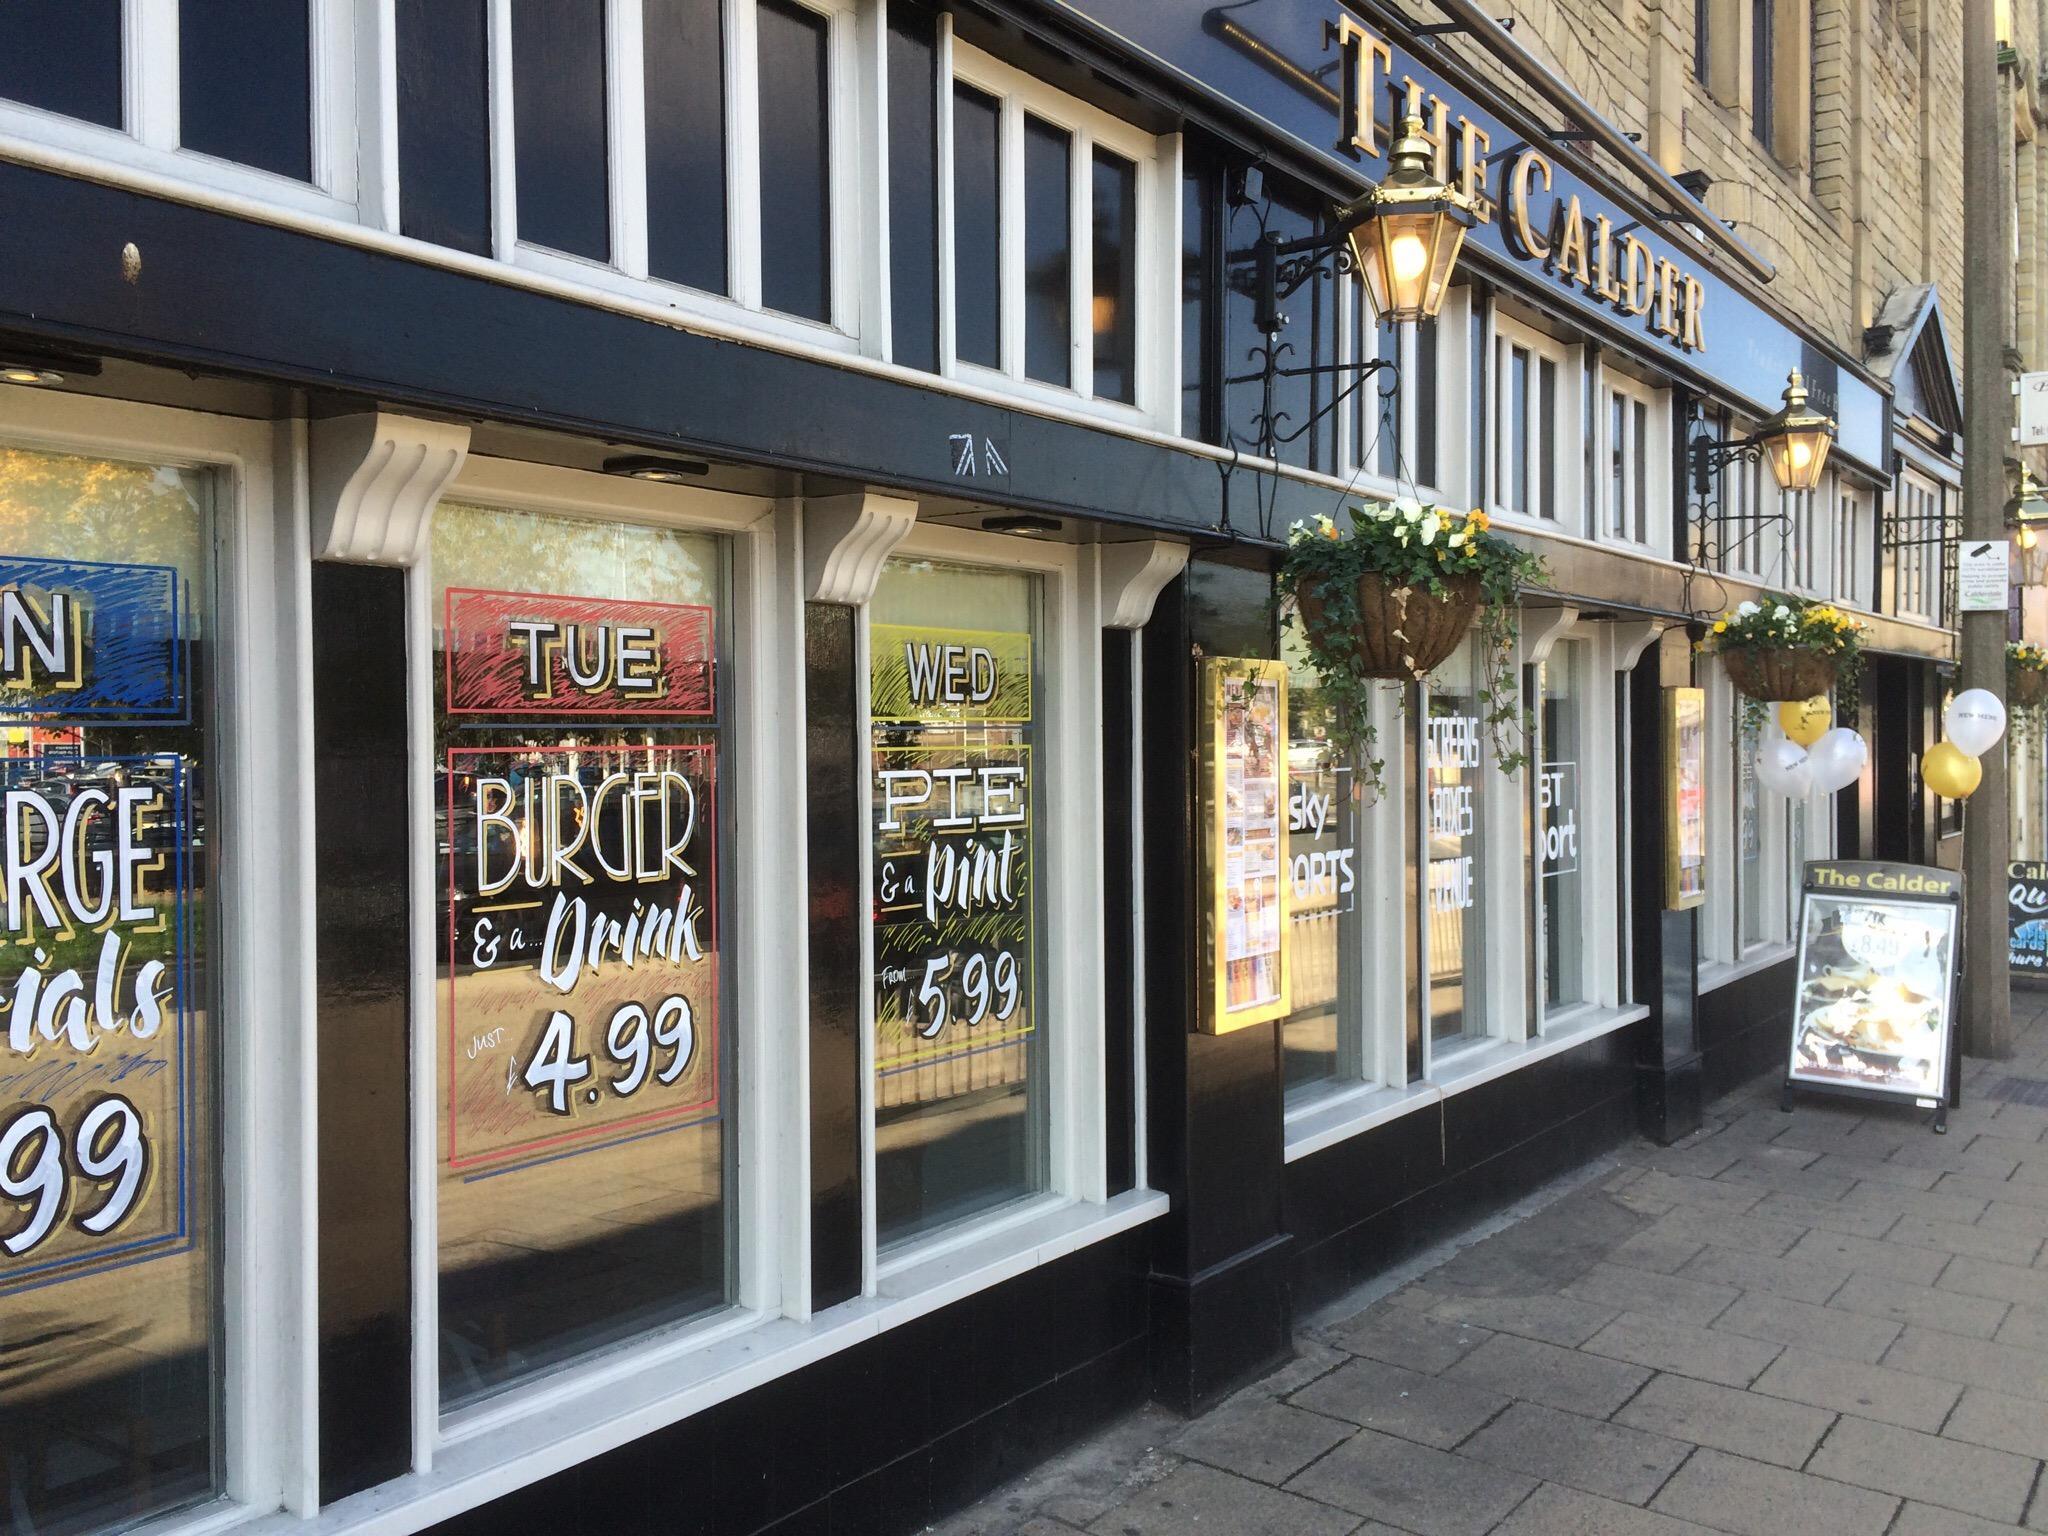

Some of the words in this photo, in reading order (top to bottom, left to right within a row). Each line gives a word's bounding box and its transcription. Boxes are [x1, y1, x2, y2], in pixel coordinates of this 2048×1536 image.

[1339, 13, 1490, 225] THE
[1513, 150, 1707, 353] CALDER
[509, 621, 655, 687] TUE
[905, 643, 996, 703] WED
[477, 770, 697, 891] BURGER
[878, 767, 1025, 830] PIE
[1289, 783, 1330, 840] sky
[4, 786, 157, 933] RGE
[926, 829, 1019, 923] pint
[1815, 868, 1860, 888] The
[1867, 872, 1951, 894] Calder
[2008, 862, 2048, 880] Cal
[2009, 883, 2048, 913] Qu
[540, 884, 704, 995] Drink
[0, 929, 174, 1053] ials
